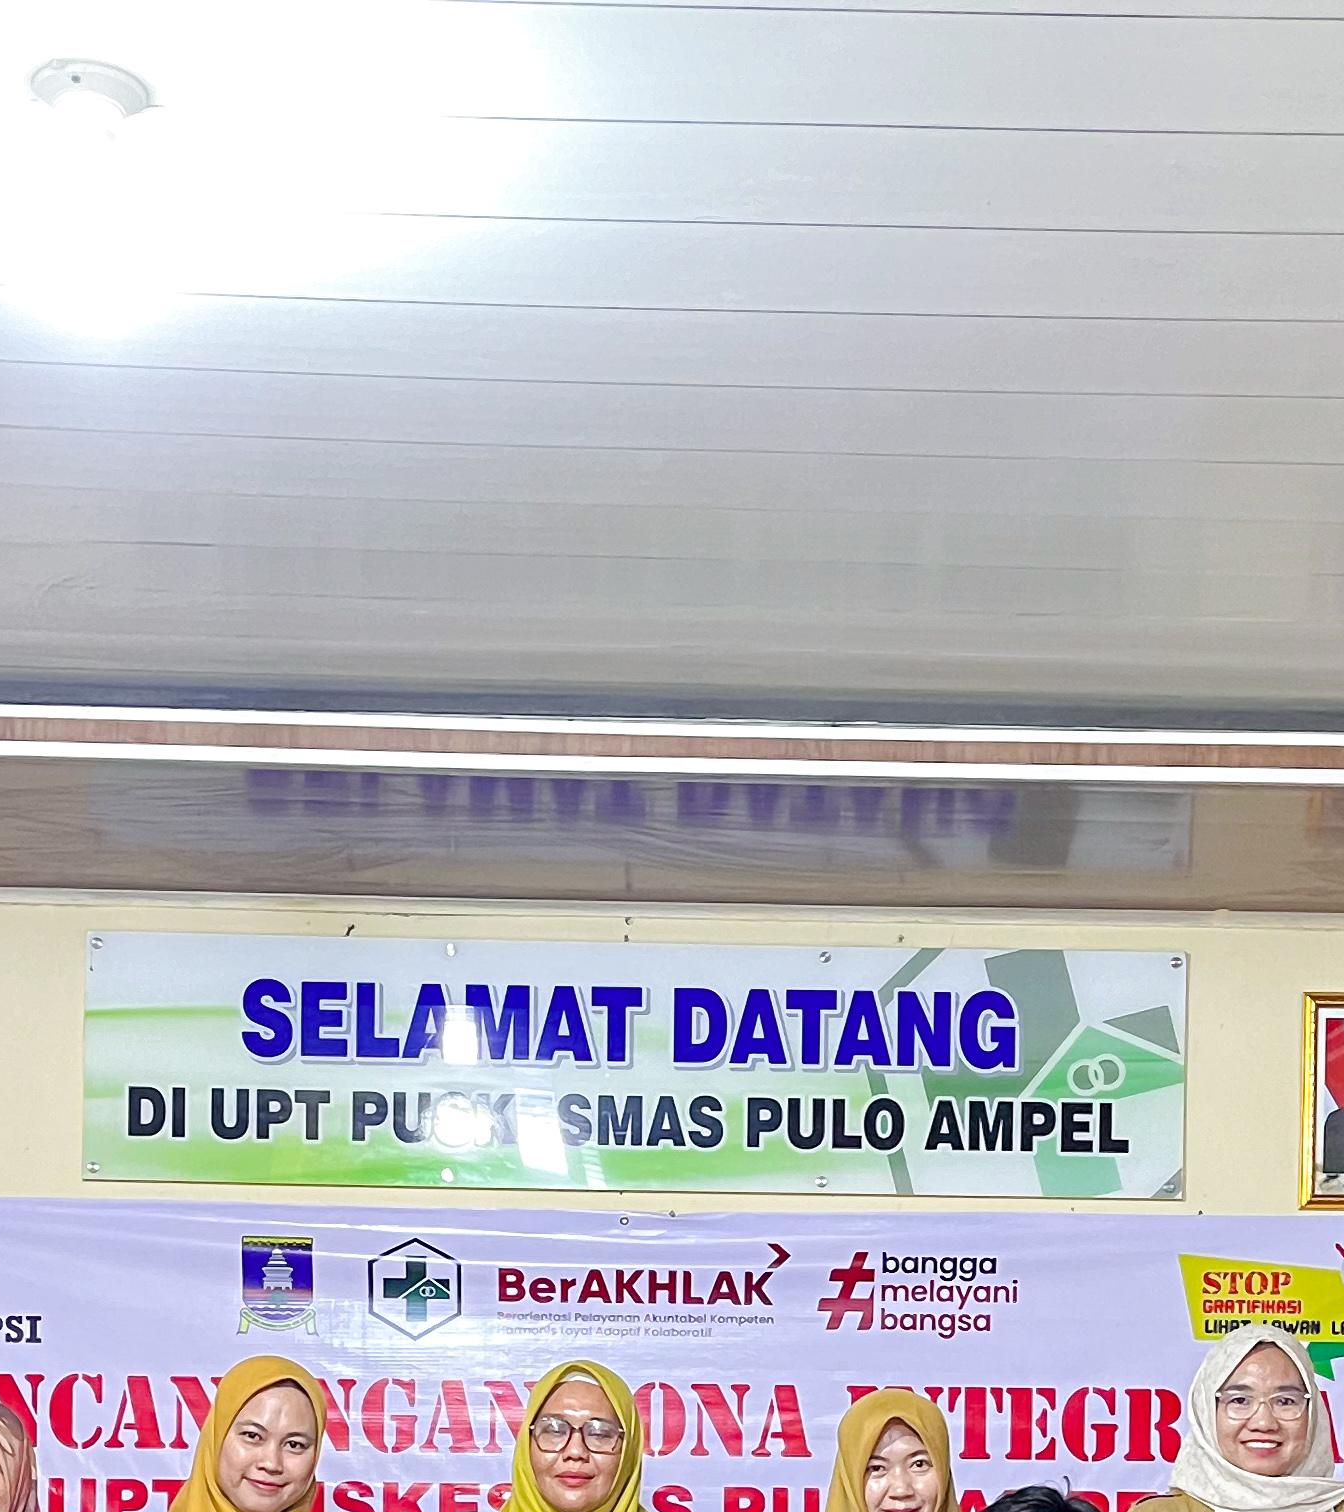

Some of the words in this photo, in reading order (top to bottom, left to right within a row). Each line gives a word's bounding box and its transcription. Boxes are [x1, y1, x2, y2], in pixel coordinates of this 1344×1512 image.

[242, 978, 644, 1063] SELAMAT
[673, 987, 1017, 1070] DATANG
[127, 1086, 186, 1138] DI
[210, 1087, 331, 1141] UPT
[352, 1090, 724, 1148] PUKSMAS
[747, 1098, 905, 1151] PULO
[924, 1100, 1130, 1154] AMPEL
[882, 1251, 997, 1282] bangga
[497, 1267, 774, 1307] BerAKHLAK
[881, 1280, 1018, 1310] melayani
[1202, 1271, 1292, 1296] STOP
[1202, 1299, 1302, 1315] GRATIFIKASI
[880, 1308, 991, 1339] bangsa
[633, 1381, 813, 1459] ONA
